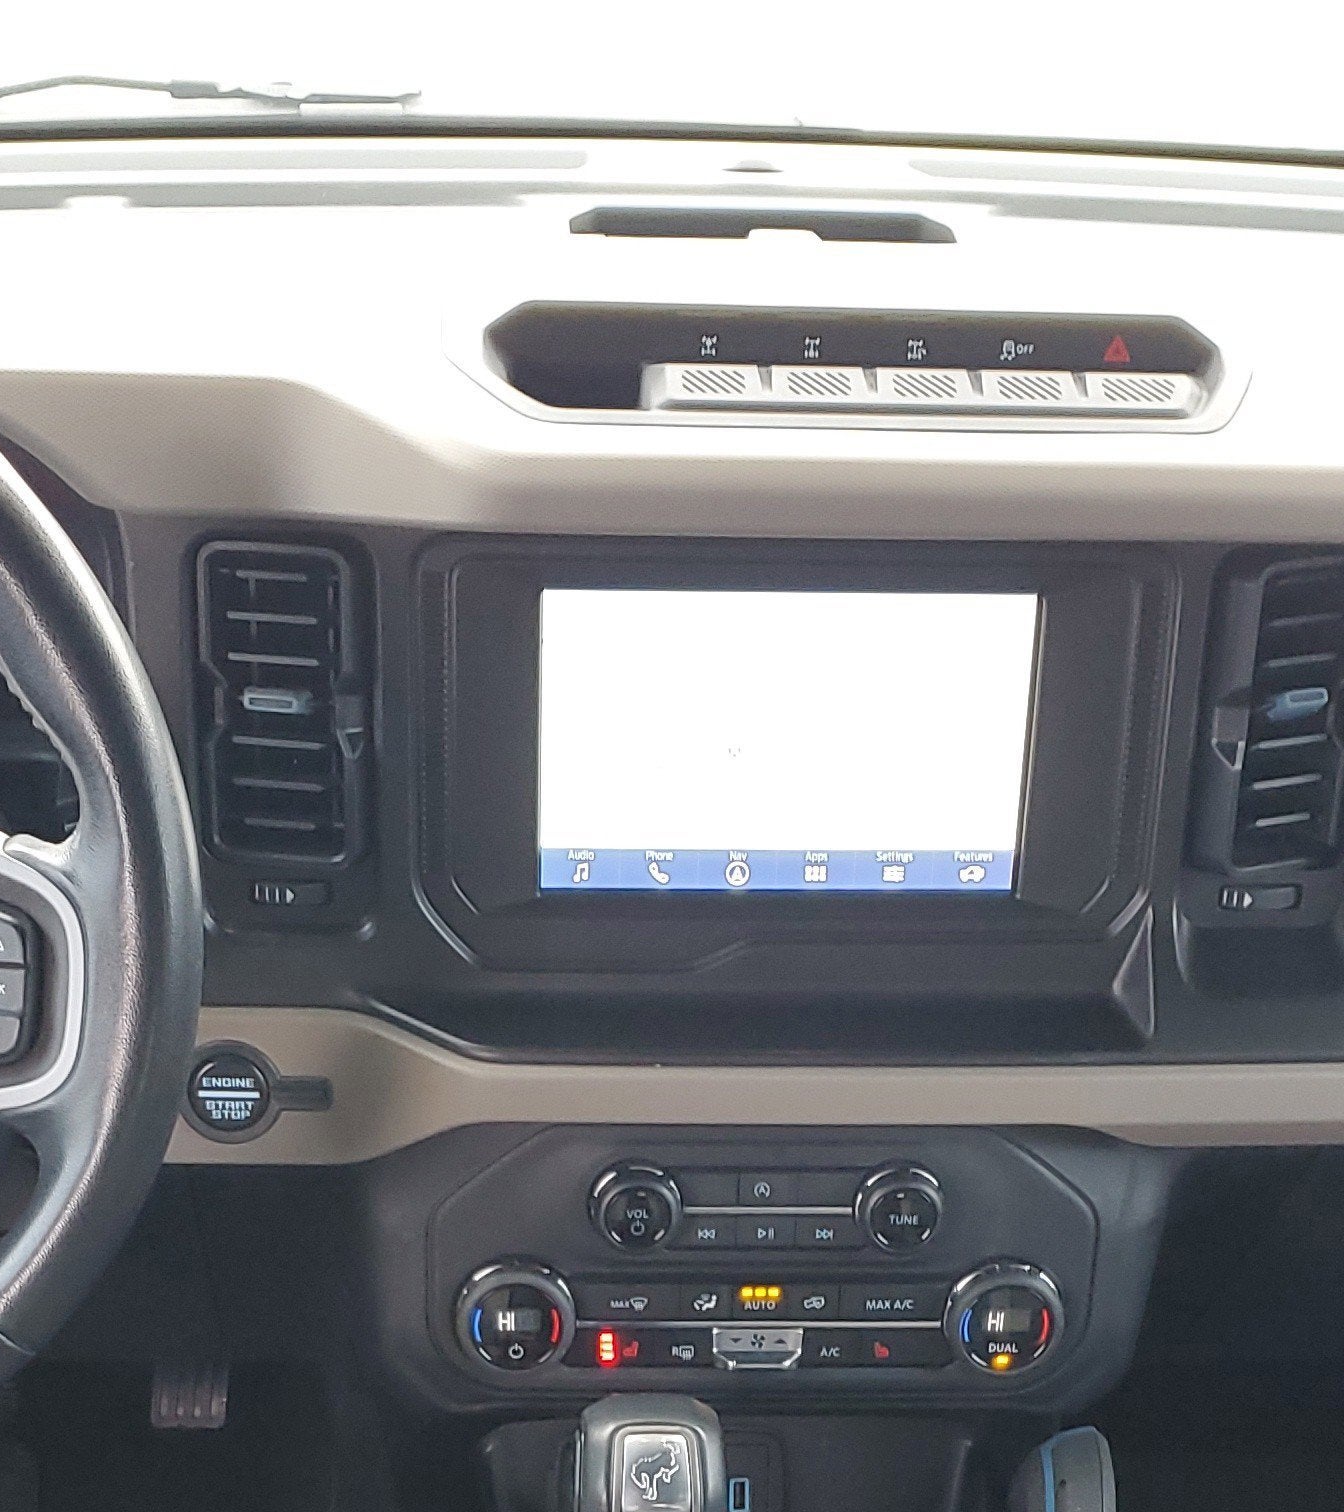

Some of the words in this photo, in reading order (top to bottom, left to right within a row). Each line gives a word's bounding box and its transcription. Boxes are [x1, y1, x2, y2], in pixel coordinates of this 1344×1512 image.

[567, 850, 595, 861] Audio
[645, 850, 674, 861] Phone
[729, 851, 747, 861] Nav
[805, 851, 828, 863] Apps
[875, 851, 914, 863] Settings
[954, 851, 993, 862] Features
[203, 1077, 255, 1088] ENGINE
[206, 1101, 254, 1111] START
[212, 1110, 251, 1120] STOP
[627, 1209, 648, 1219] VOL
[889, 1214, 919, 1225] TUNE
[744, 1301, 776, 1311] AUTO
[865, 1300, 890, 1311] MAX
[893, 1300, 914, 1311] A/C
[497, 1311, 515, 1332] HI
[987, 1311, 1005, 1332] HI
[820, 1347, 840, 1358] A/C
[988, 1342, 1019, 1353] DUAL
